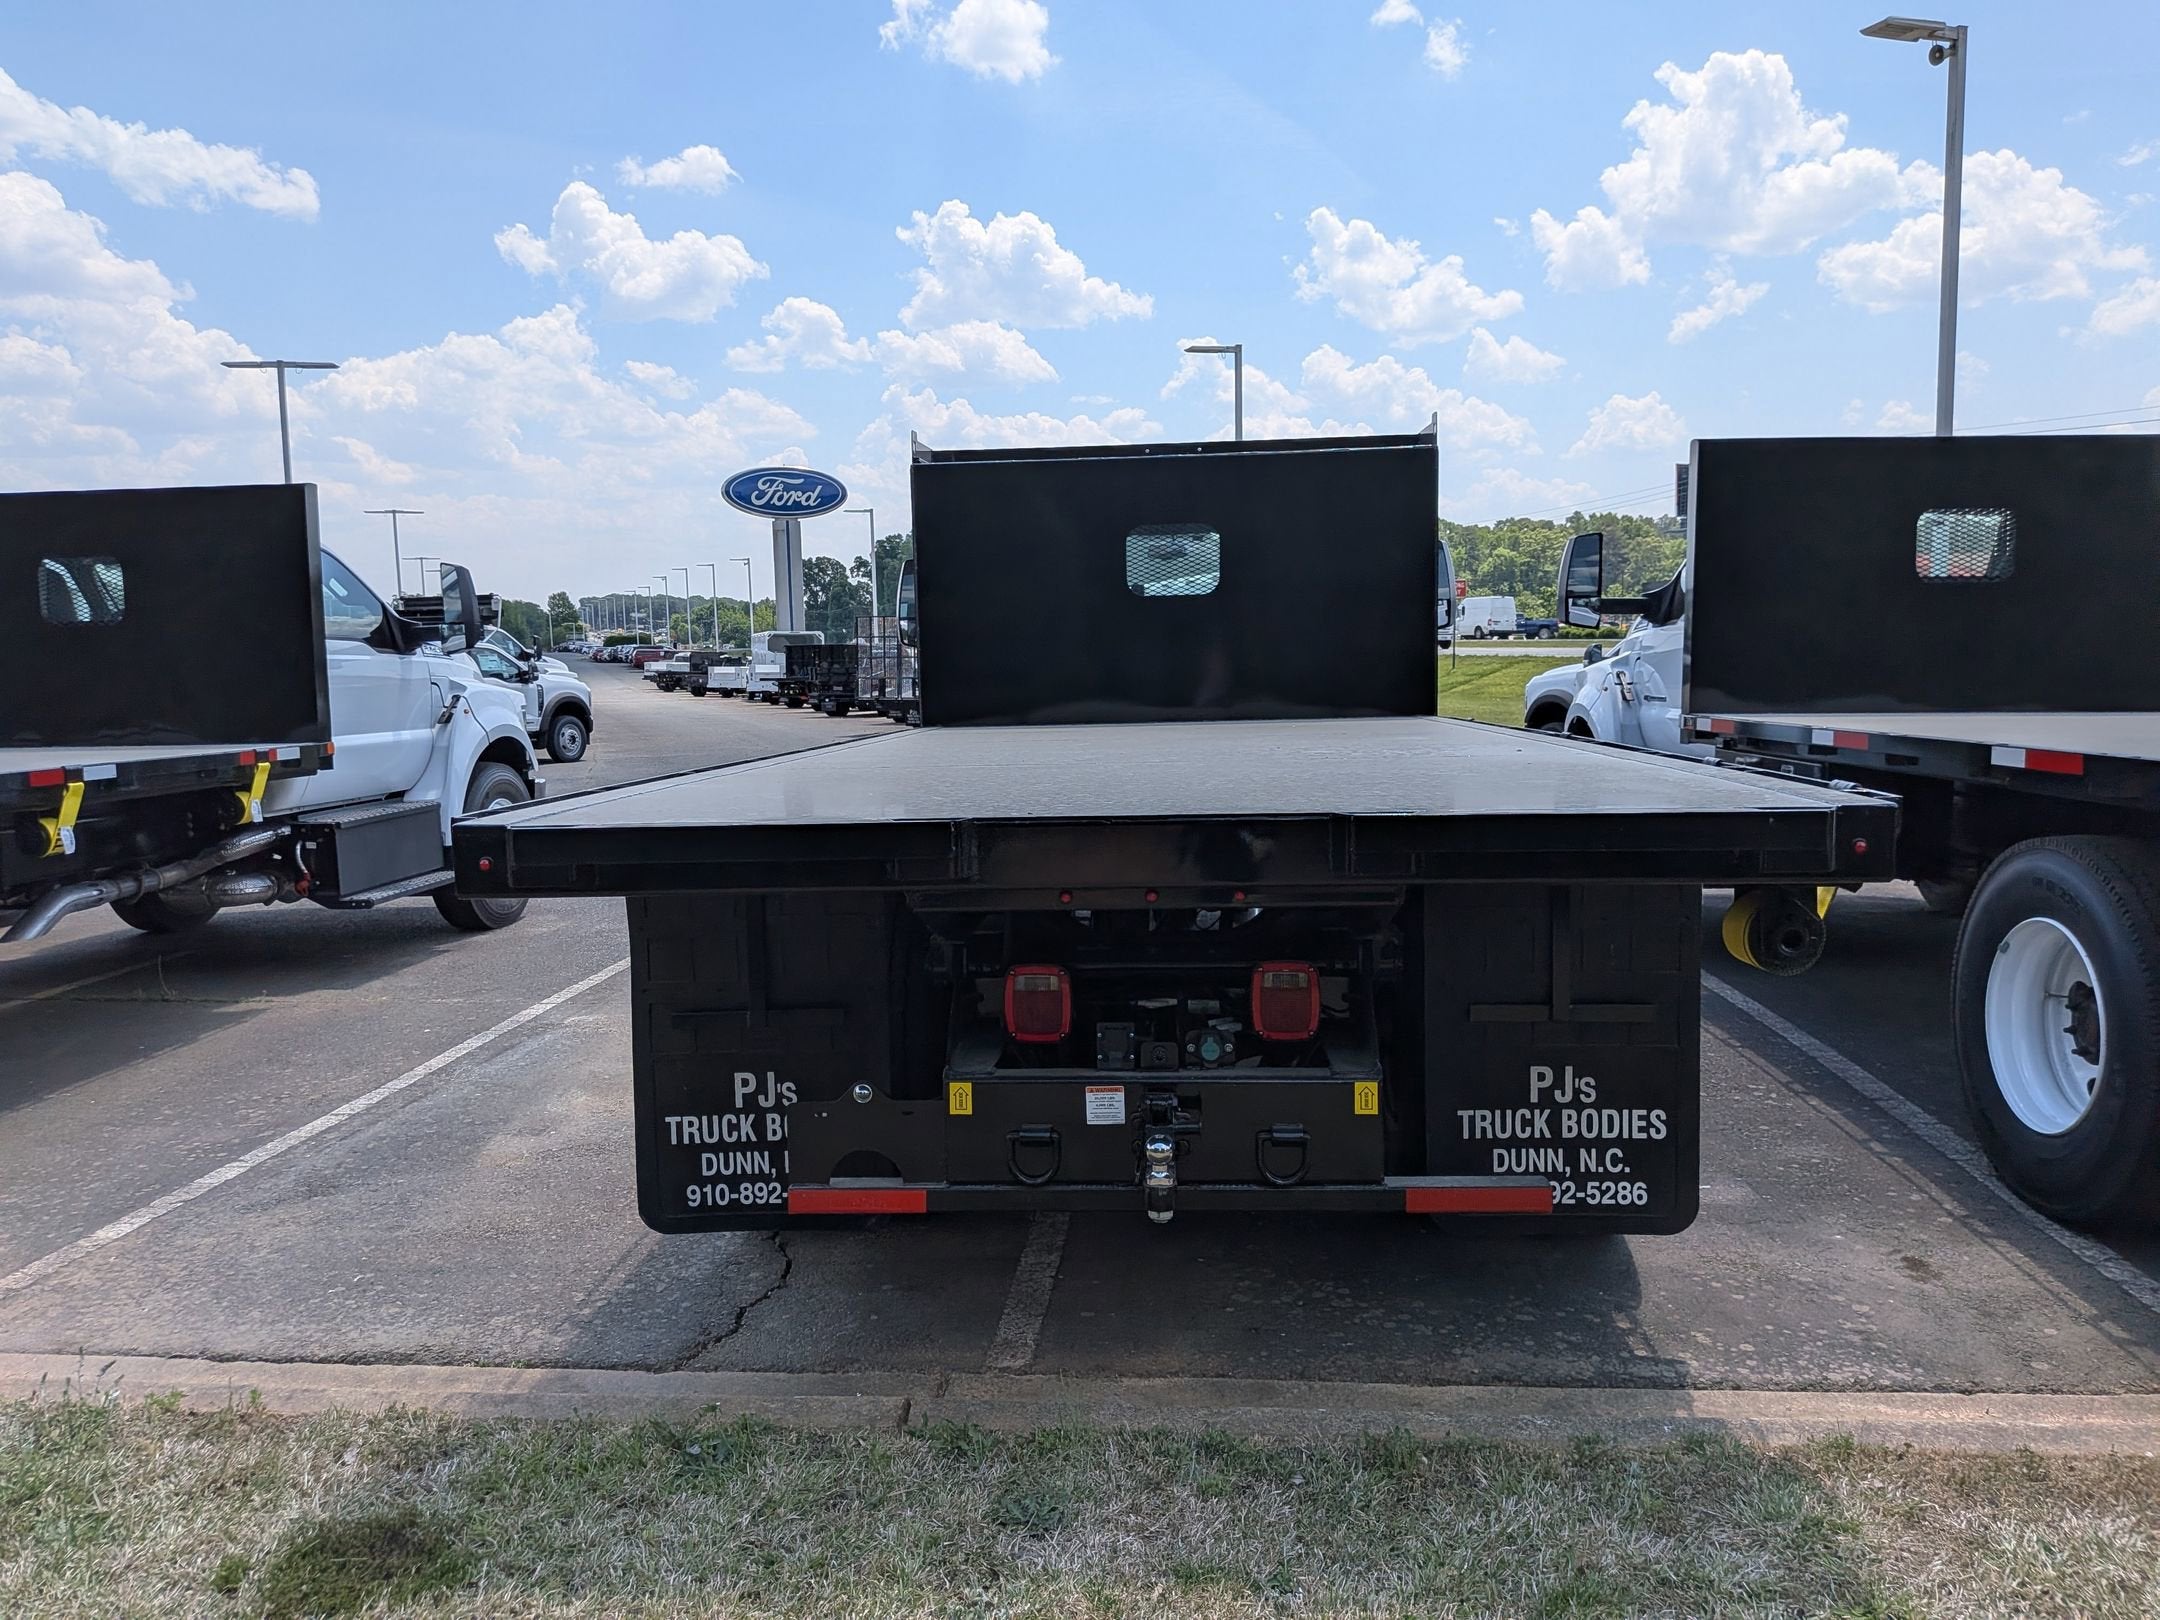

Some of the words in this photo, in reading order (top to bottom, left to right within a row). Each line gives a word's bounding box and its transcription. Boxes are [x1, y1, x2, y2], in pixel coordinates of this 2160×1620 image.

[750, 476, 822, 506] Ford
[733, 1071, 798, 1108] PJ's
[1530, 1065, 1597, 1103] PJ's
[665, 1113, 757, 1145] TRUCK
[1457, 1108, 1552, 1140] TRUCK
[1561, 1108, 1667, 1140] BODIES
[701, 1151, 776, 1179] DUNN,
[1493, 1148, 1571, 1178] DUNN,
[1579, 1147, 1631, 1173] N.C.
